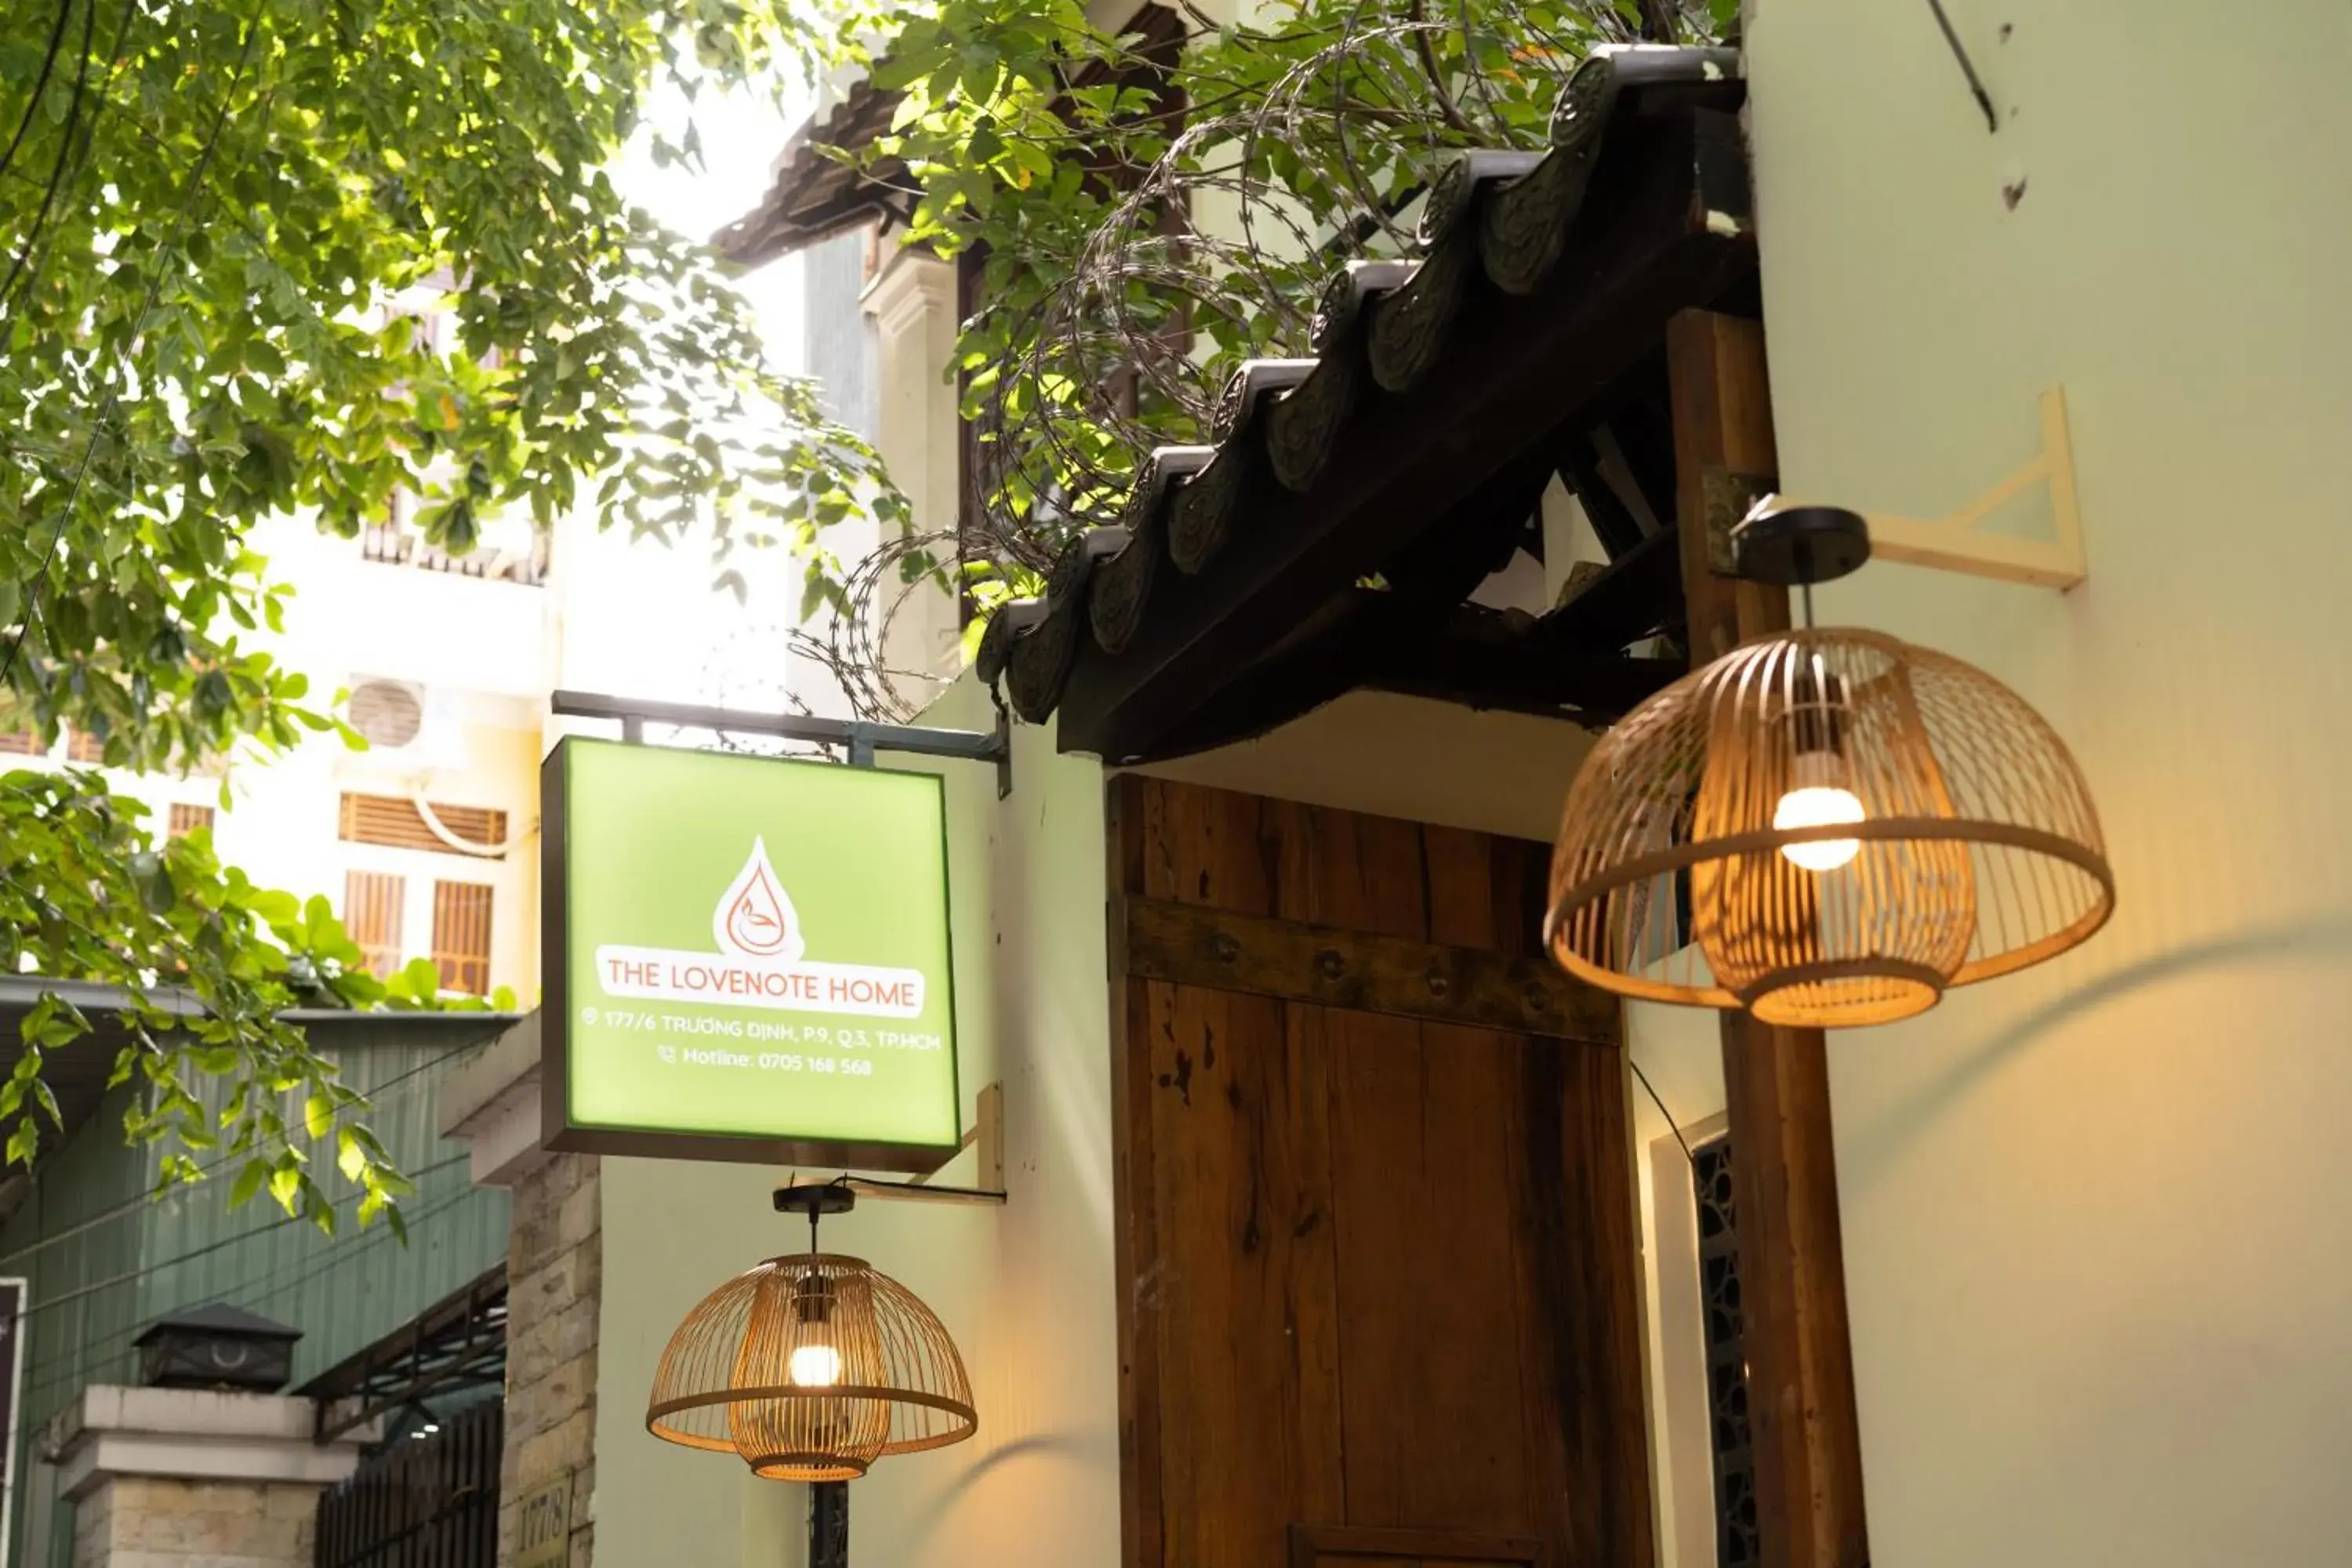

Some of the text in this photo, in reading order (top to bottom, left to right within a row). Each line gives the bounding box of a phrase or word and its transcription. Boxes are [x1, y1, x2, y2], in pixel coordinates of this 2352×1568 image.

[608, 959, 916, 1007] THE LOVENOTE HOME
[604, 1011, 657, 1031] 177/6
[683, 1047, 755, 1067] Hotline:
[758, 1052, 803, 1072] 0705
